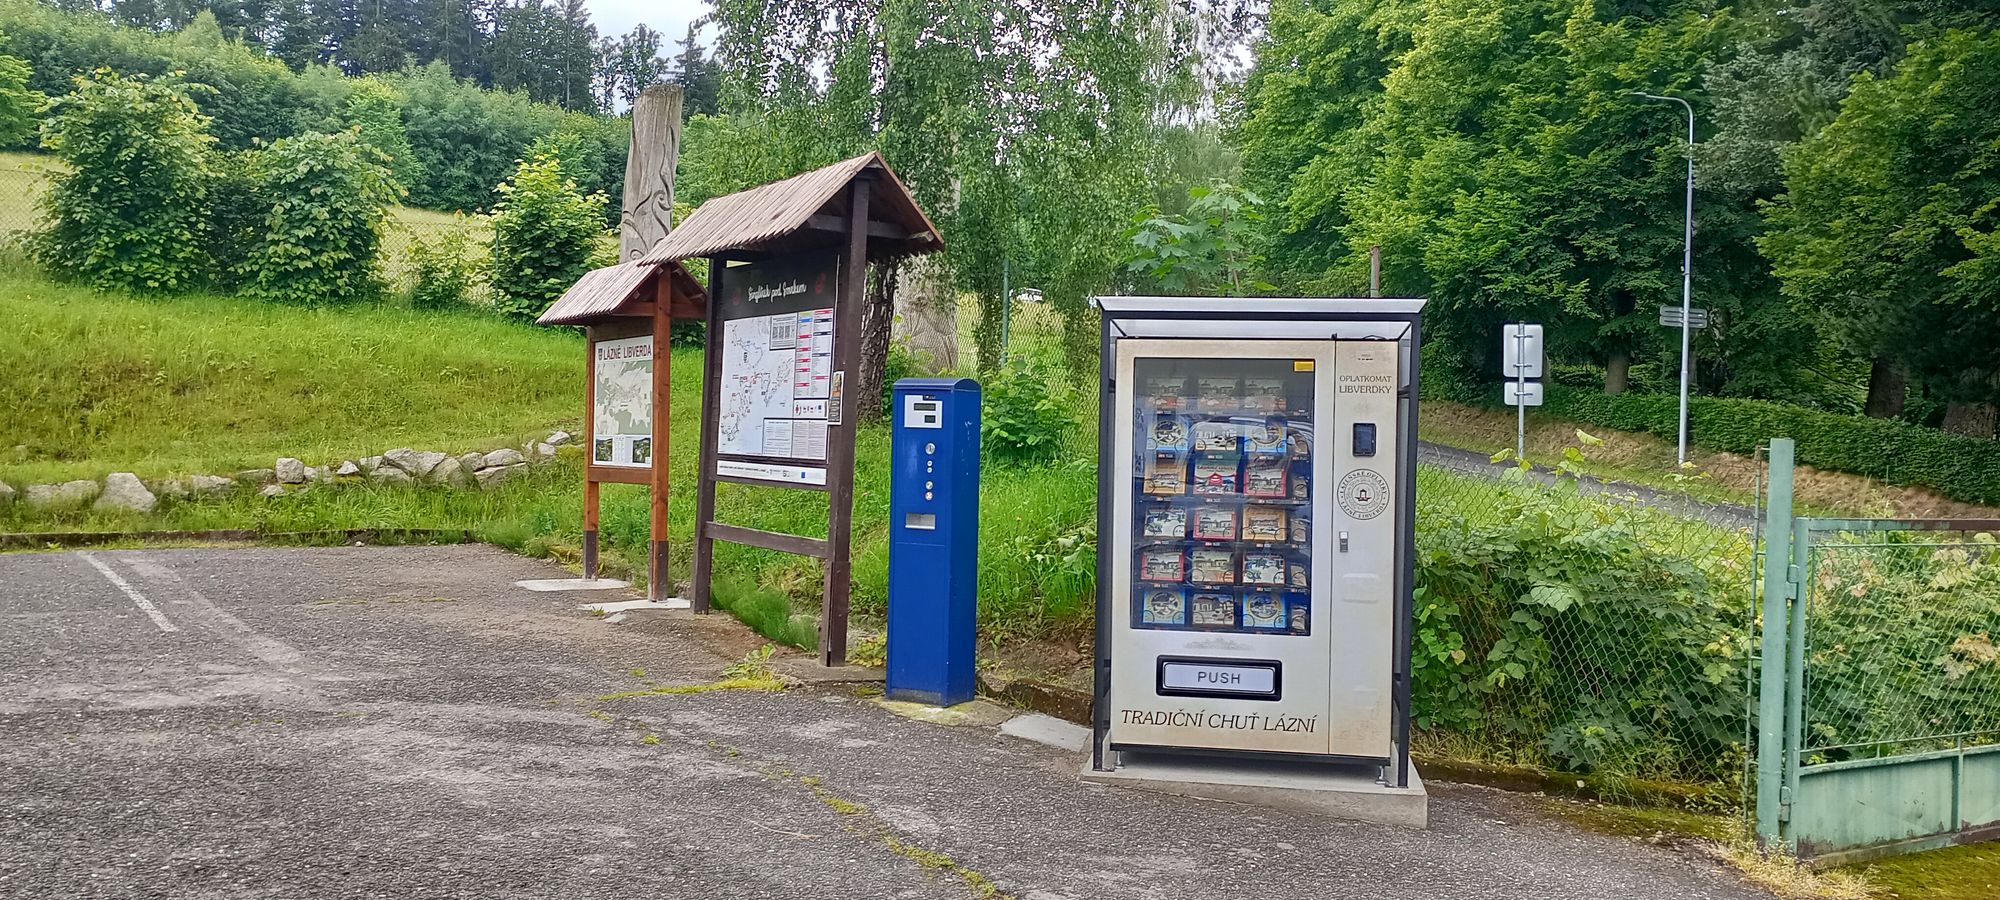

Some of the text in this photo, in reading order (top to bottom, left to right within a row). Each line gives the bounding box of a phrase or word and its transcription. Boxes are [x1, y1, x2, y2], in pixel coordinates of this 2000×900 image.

[770, 282, 782, 302] pod
[604, 344, 651, 360] LÁZNĚ LIBVERDA
[1340, 386, 1392, 394] LIBVERDKY
[1197, 671, 1240, 684] PUSH
[1121, 708, 1316, 732] TRADIČNÍ CHUŤ LÁZNÍ
